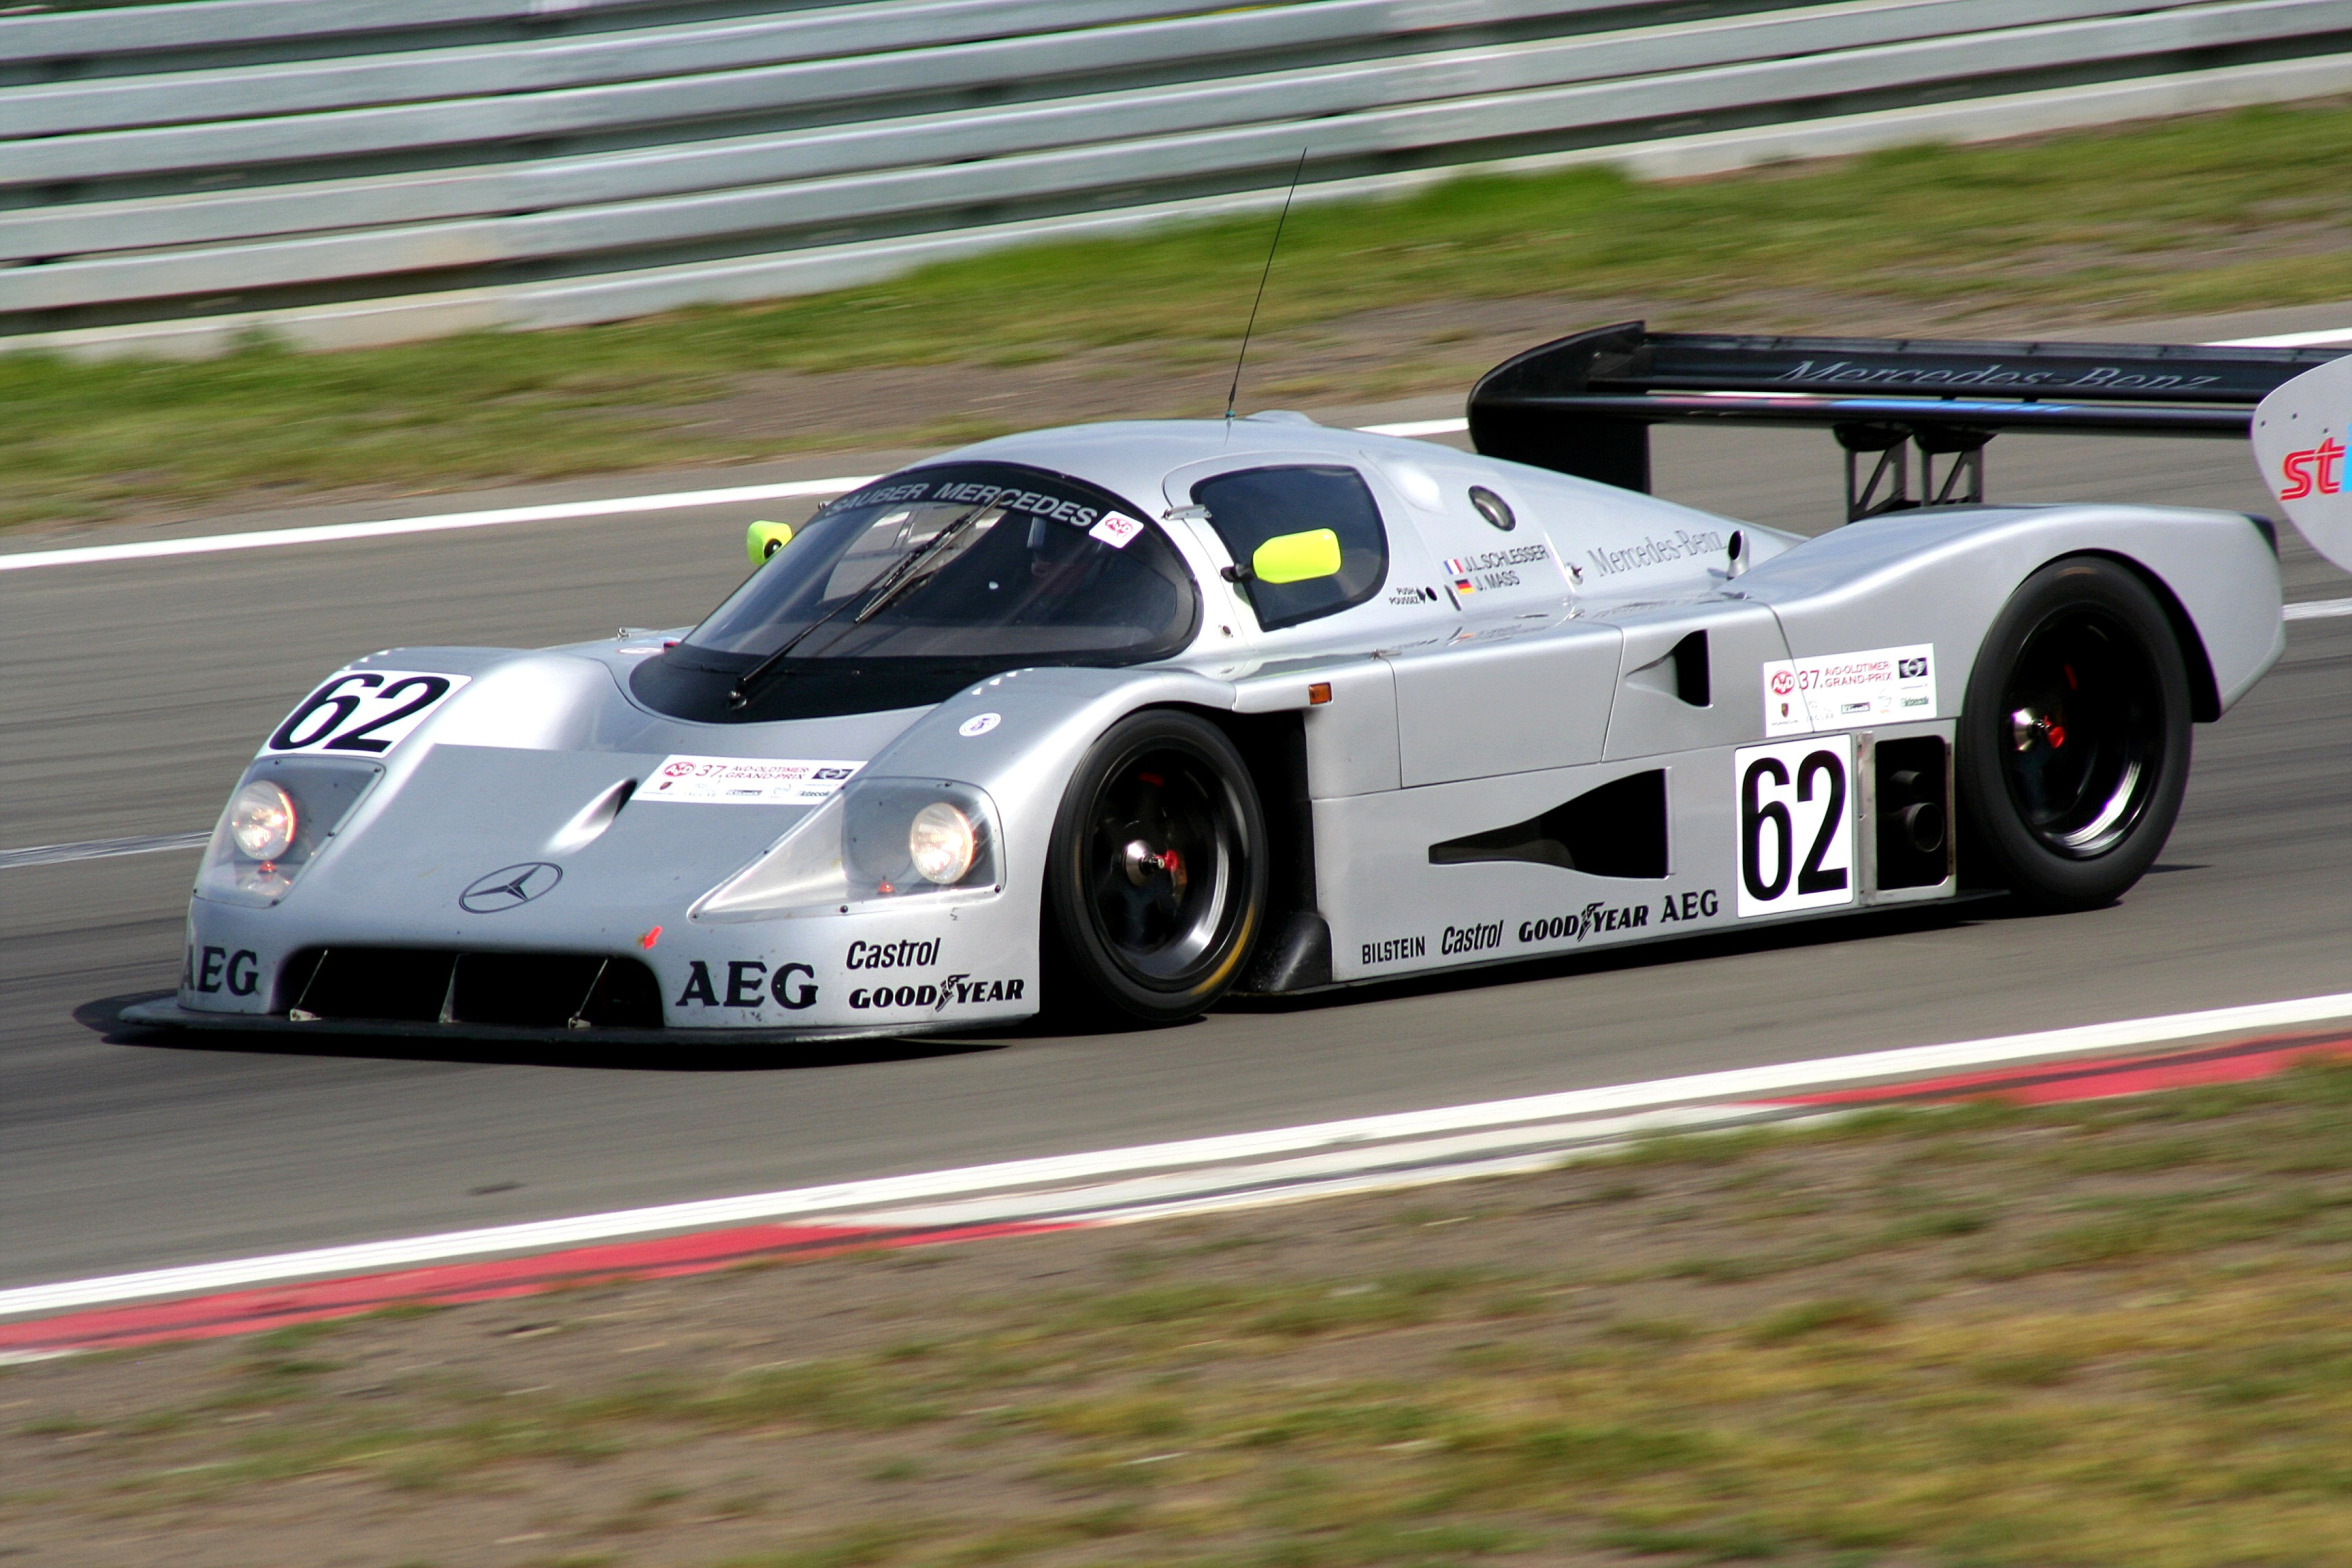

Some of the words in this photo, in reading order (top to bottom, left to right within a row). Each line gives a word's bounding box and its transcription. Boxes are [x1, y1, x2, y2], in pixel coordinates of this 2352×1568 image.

[1770, 358, 2223, 391] Mercedes-Benz
[932, 482, 1098, 528] MERCEDES
[1586, 529, 1727, 577] Mercedes-Benz
[1488, 569, 1521, 590] MASS
[268, 673, 450, 753] 62
[1741, 749, 1848, 902] 62
[1659, 888, 1719, 924] AEG
[846, 936, 941, 971] Castrol
[1361, 935, 1426, 966] BILSTEIN
[1440, 919, 1505, 956] Castrol
[674, 960, 819, 1011] AEG
